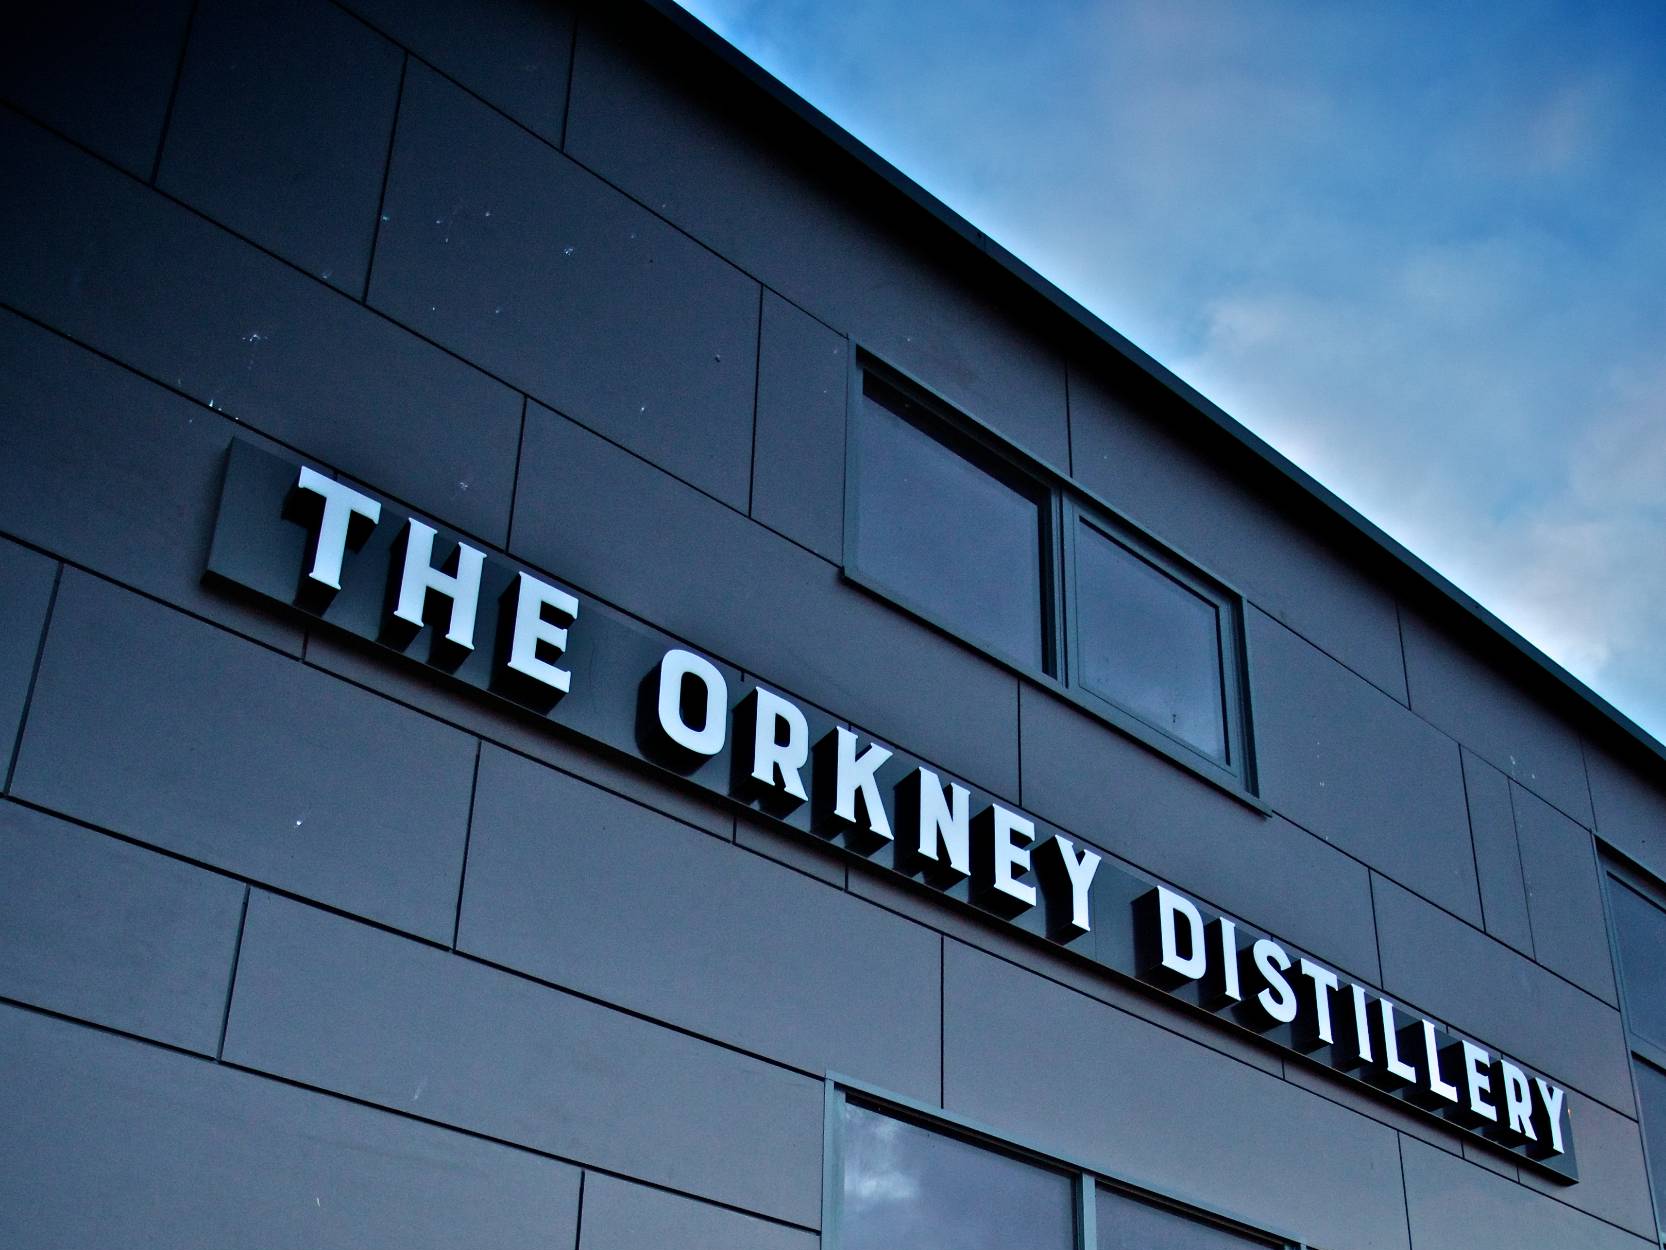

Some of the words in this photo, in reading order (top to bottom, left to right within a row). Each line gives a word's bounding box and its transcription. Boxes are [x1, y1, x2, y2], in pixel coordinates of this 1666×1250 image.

[298, 465, 579, 693] THE
[658, 649, 1102, 932] ORKNEY
[1156, 885, 1565, 1154] DISTILLERY
